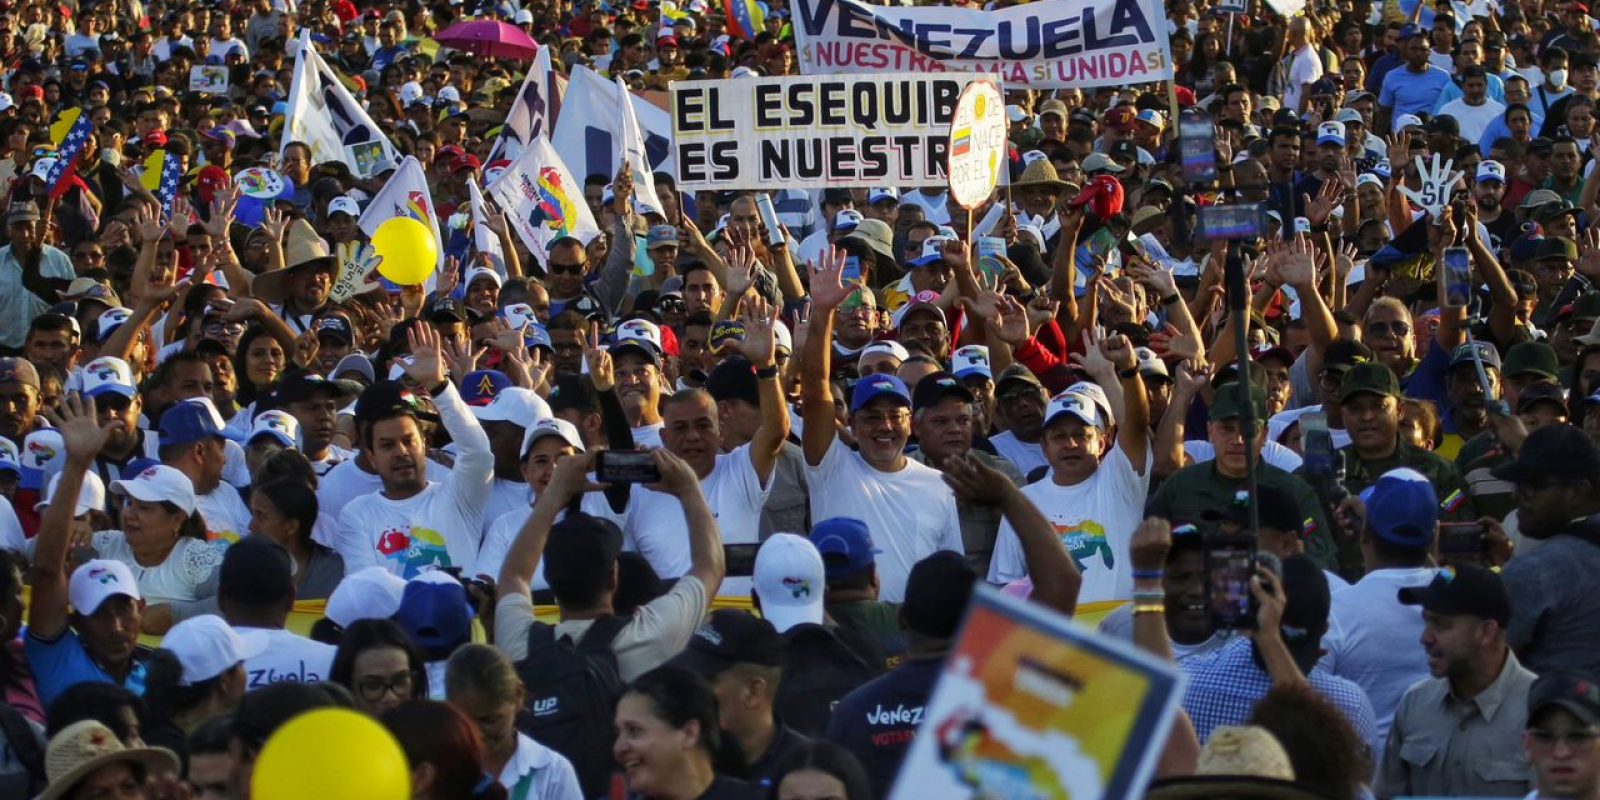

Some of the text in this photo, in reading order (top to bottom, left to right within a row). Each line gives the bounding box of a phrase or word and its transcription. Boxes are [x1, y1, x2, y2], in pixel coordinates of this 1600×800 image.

[798, 0, 1155, 60] VENEZUELA
[816, 41, 946, 72] NUESTRA
[1057, 50, 1147, 82] UNIDA
[675, 79, 973, 133] EL ESEQUIB
[678, 139, 739, 182] ES
[760, 135, 949, 182] NUESTR
[533, 696, 558, 711] UP
